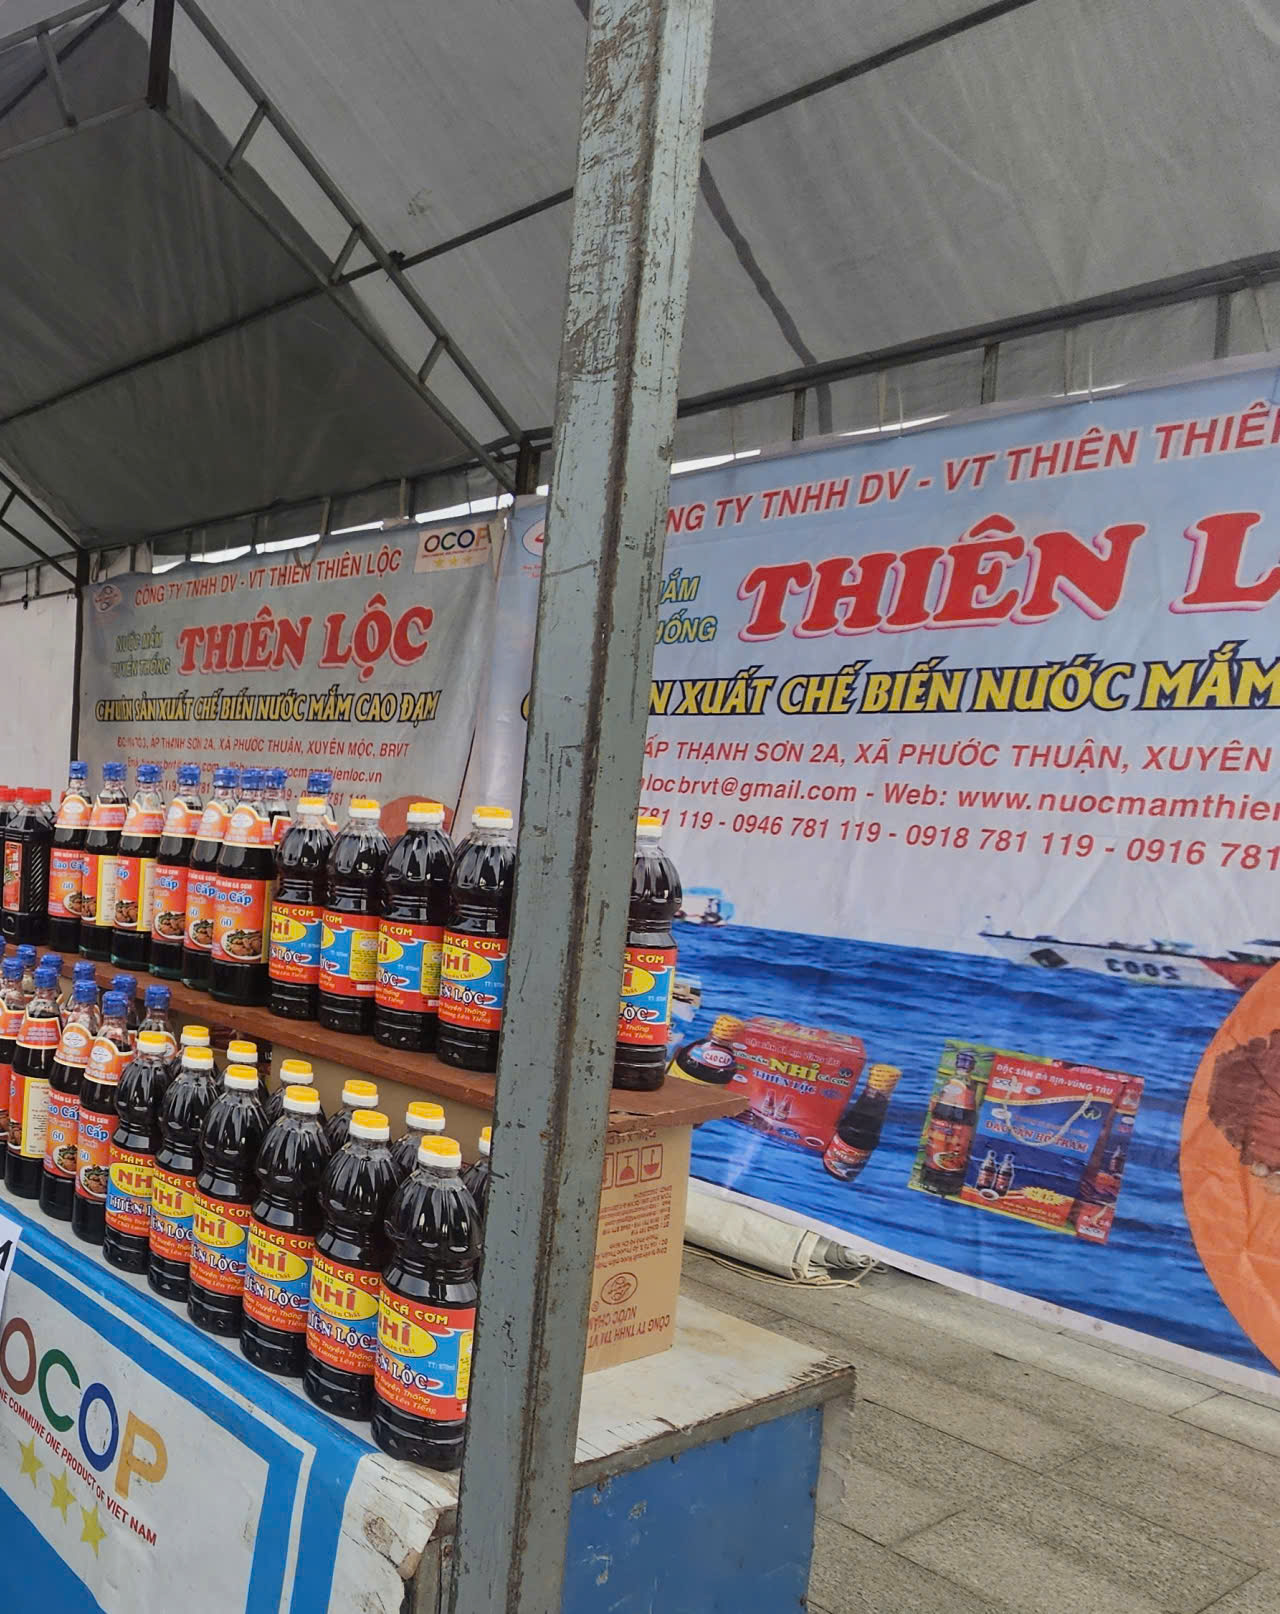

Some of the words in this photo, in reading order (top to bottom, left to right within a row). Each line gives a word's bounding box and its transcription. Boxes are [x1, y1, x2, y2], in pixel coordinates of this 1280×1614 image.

[715, 496, 754, 528] TY
[761, 480, 850, 521] TNHH
[858, 468, 911, 505] DV
[945, 455, 996, 493] VT
[1006, 427, 1138, 482] THIÊN
[1156, 400, 1280, 461] THIÊ
[134, 583, 166, 609] CÔNG
[169, 581, 182, 602] TY
[185, 577, 218, 598] TNHH
[220, 575, 239, 594] DV
[248, 573, 265, 590] VT
[317, 551, 362, 581] THIÊN
[367, 545, 403, 578] LỘC
[737, 512, 1149, 643] THIÊN
[176, 604, 313, 676] THIÊN
[319, 592, 435, 682] LỘC
[670, 664, 779, 717] XUẤT
[777, 659, 872, 717] CHẾ
[857, 656, 974, 714] BIẾN
[971, 654, 1136, 714] NƯỚC
[1132, 640, 1280, 713] MẮM
[134, 690, 158, 722] SẢN
[157, 689, 195, 722] XUẤT
[194, 687, 224, 722] CHẾ
[221, 687, 256, 722] BIẾN
[255, 687, 309, 722] NƯỚC
[308, 683, 355, 722] MẮM
[355, 692, 399, 723] CAO
[397, 689, 443, 728] ĐẠM
[306, 737, 345, 757] XUYÊN
[379, 742, 410, 758] BRVT
[675, 740, 750, 765] THẠNH
[754, 739, 805, 763] SƠN
[809, 743, 846, 768] 2A,
[853, 737, 892, 766] XÃ
[897, 739, 1001, 768] PHƯỚC
[1011, 739, 1129, 775] THUẬN,
[1142, 740, 1272, 774] XUYÊN
[884, 782, 947, 808] Web:
[678, 809, 714, 831] 119
[732, 812, 784, 837] 0946
[790, 816, 830, 840] 781
[839, 820, 881, 845] 119
[904, 823, 971, 852] 0918
[979, 828, 1028, 855] 781
[1041, 832, 1095, 858] 119
[1125, 837, 1206, 867] 0916
[1219, 842, 1280, 872] 781
[228, 890, 253, 905] Cấp
[291, 908, 315, 917] CƠM
[389, 926, 413, 937] CƠM
[455, 937, 469, 948] CÁ
[473, 940, 502, 951] CƠM
[636, 953, 665, 964] CƠM
[453, 985, 486, 1006] LỘC
[51, 1130, 64, 1143] 60
[86, 1121, 109, 1141] Cấp
[120, 1152, 144, 1166] MẮM
[109, 1193, 144, 1215] THIÊN
[269, 1232, 285, 1246] CÁ
[209, 1254, 240, 1274] LỘC
[338, 1269, 355, 1283] CÁ
[267, 1288, 302, 1309] LỘC
[392, 1299, 410, 1316] CÁ
[414, 1309, 449, 1325] CƠM
[335, 1326, 372, 1350] LỘC
[637, 1320, 647, 1335] TY
[391, 1363, 429, 1390] LỘC
[8, 1396, 46, 1439] COMMUNE
[45, 1431, 61, 1455] ONE
[60, 1447, 97, 1494] PRODUCT
[96, 1485, 107, 1503] OF
[106, 1495, 130, 1524] VIET
[129, 1516, 158, 1547] NAM
